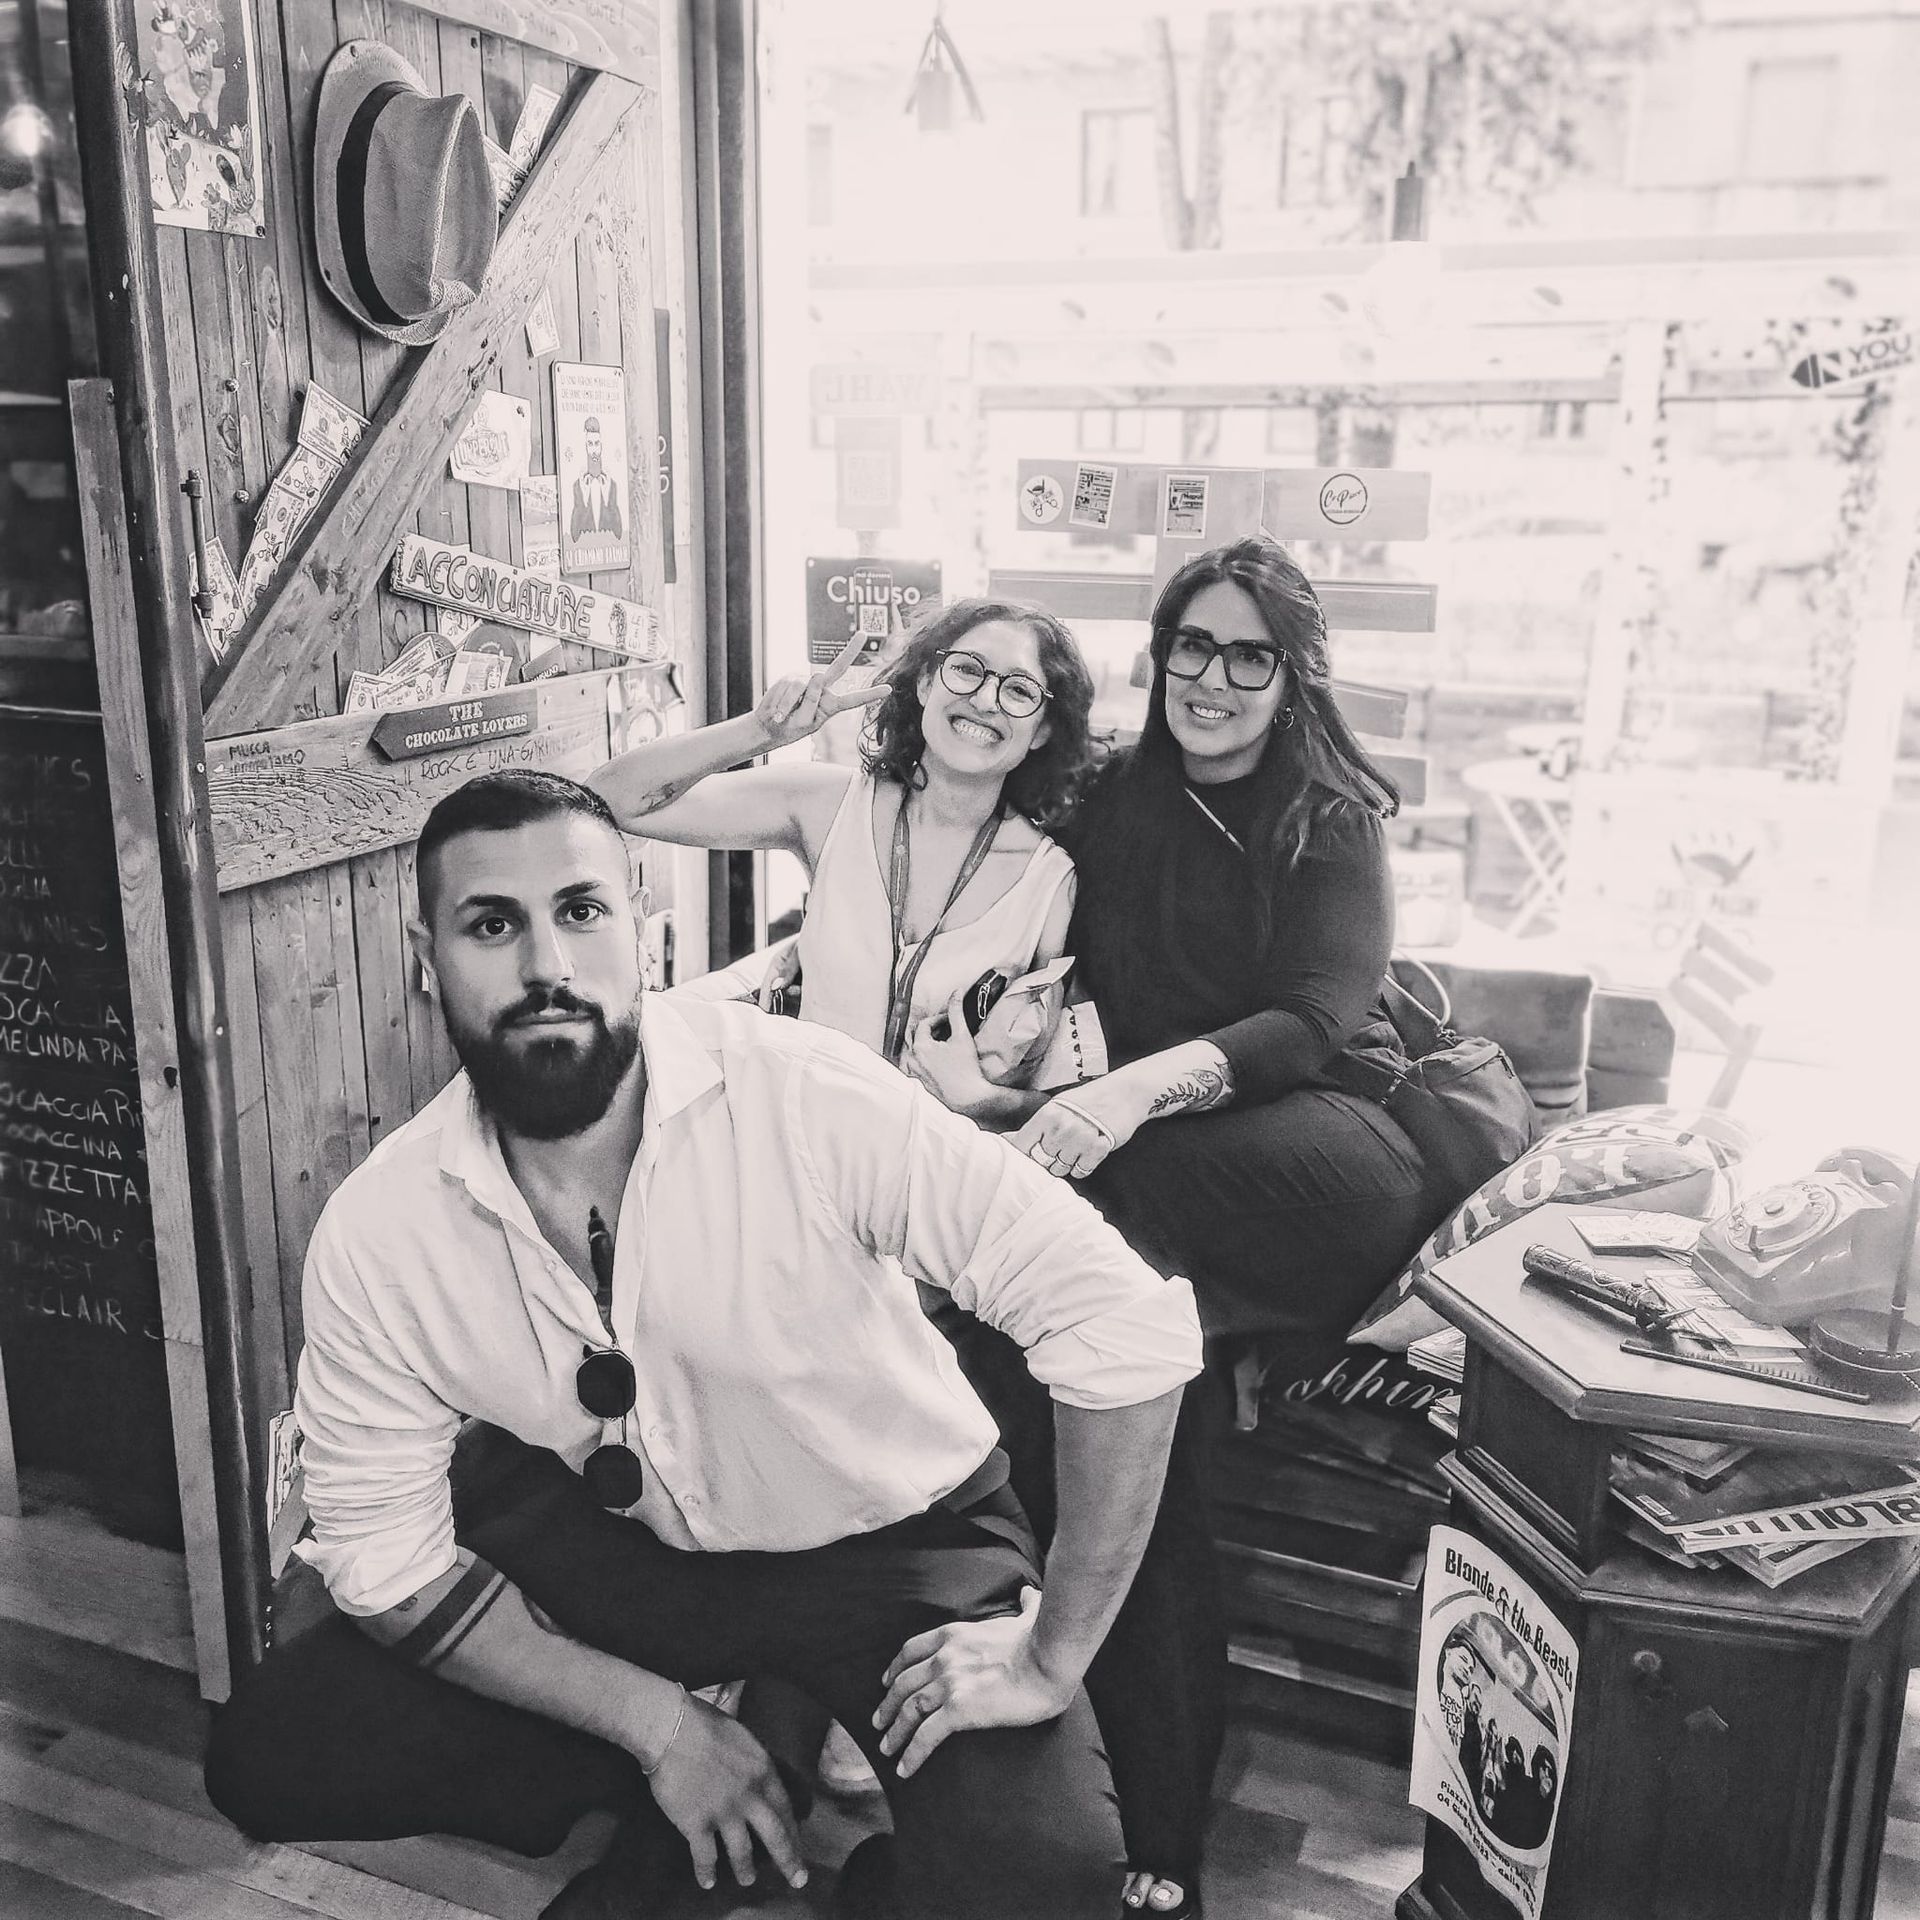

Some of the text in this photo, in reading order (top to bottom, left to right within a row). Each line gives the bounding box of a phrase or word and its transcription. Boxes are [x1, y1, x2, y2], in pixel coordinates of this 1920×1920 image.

[407, 546, 595, 638] ACCONCIATURE
[827, 575, 921, 605] Chiuso
[449, 701, 484, 723] THE
[405, 713, 529, 749] CHOCOLATE LOVERS
[421, 755, 461, 780] ROCK
[1445, 1547, 1494, 1602] Blonde
[1494, 1586, 1511, 1621] &
[1511, 1599, 1531, 1643] the
